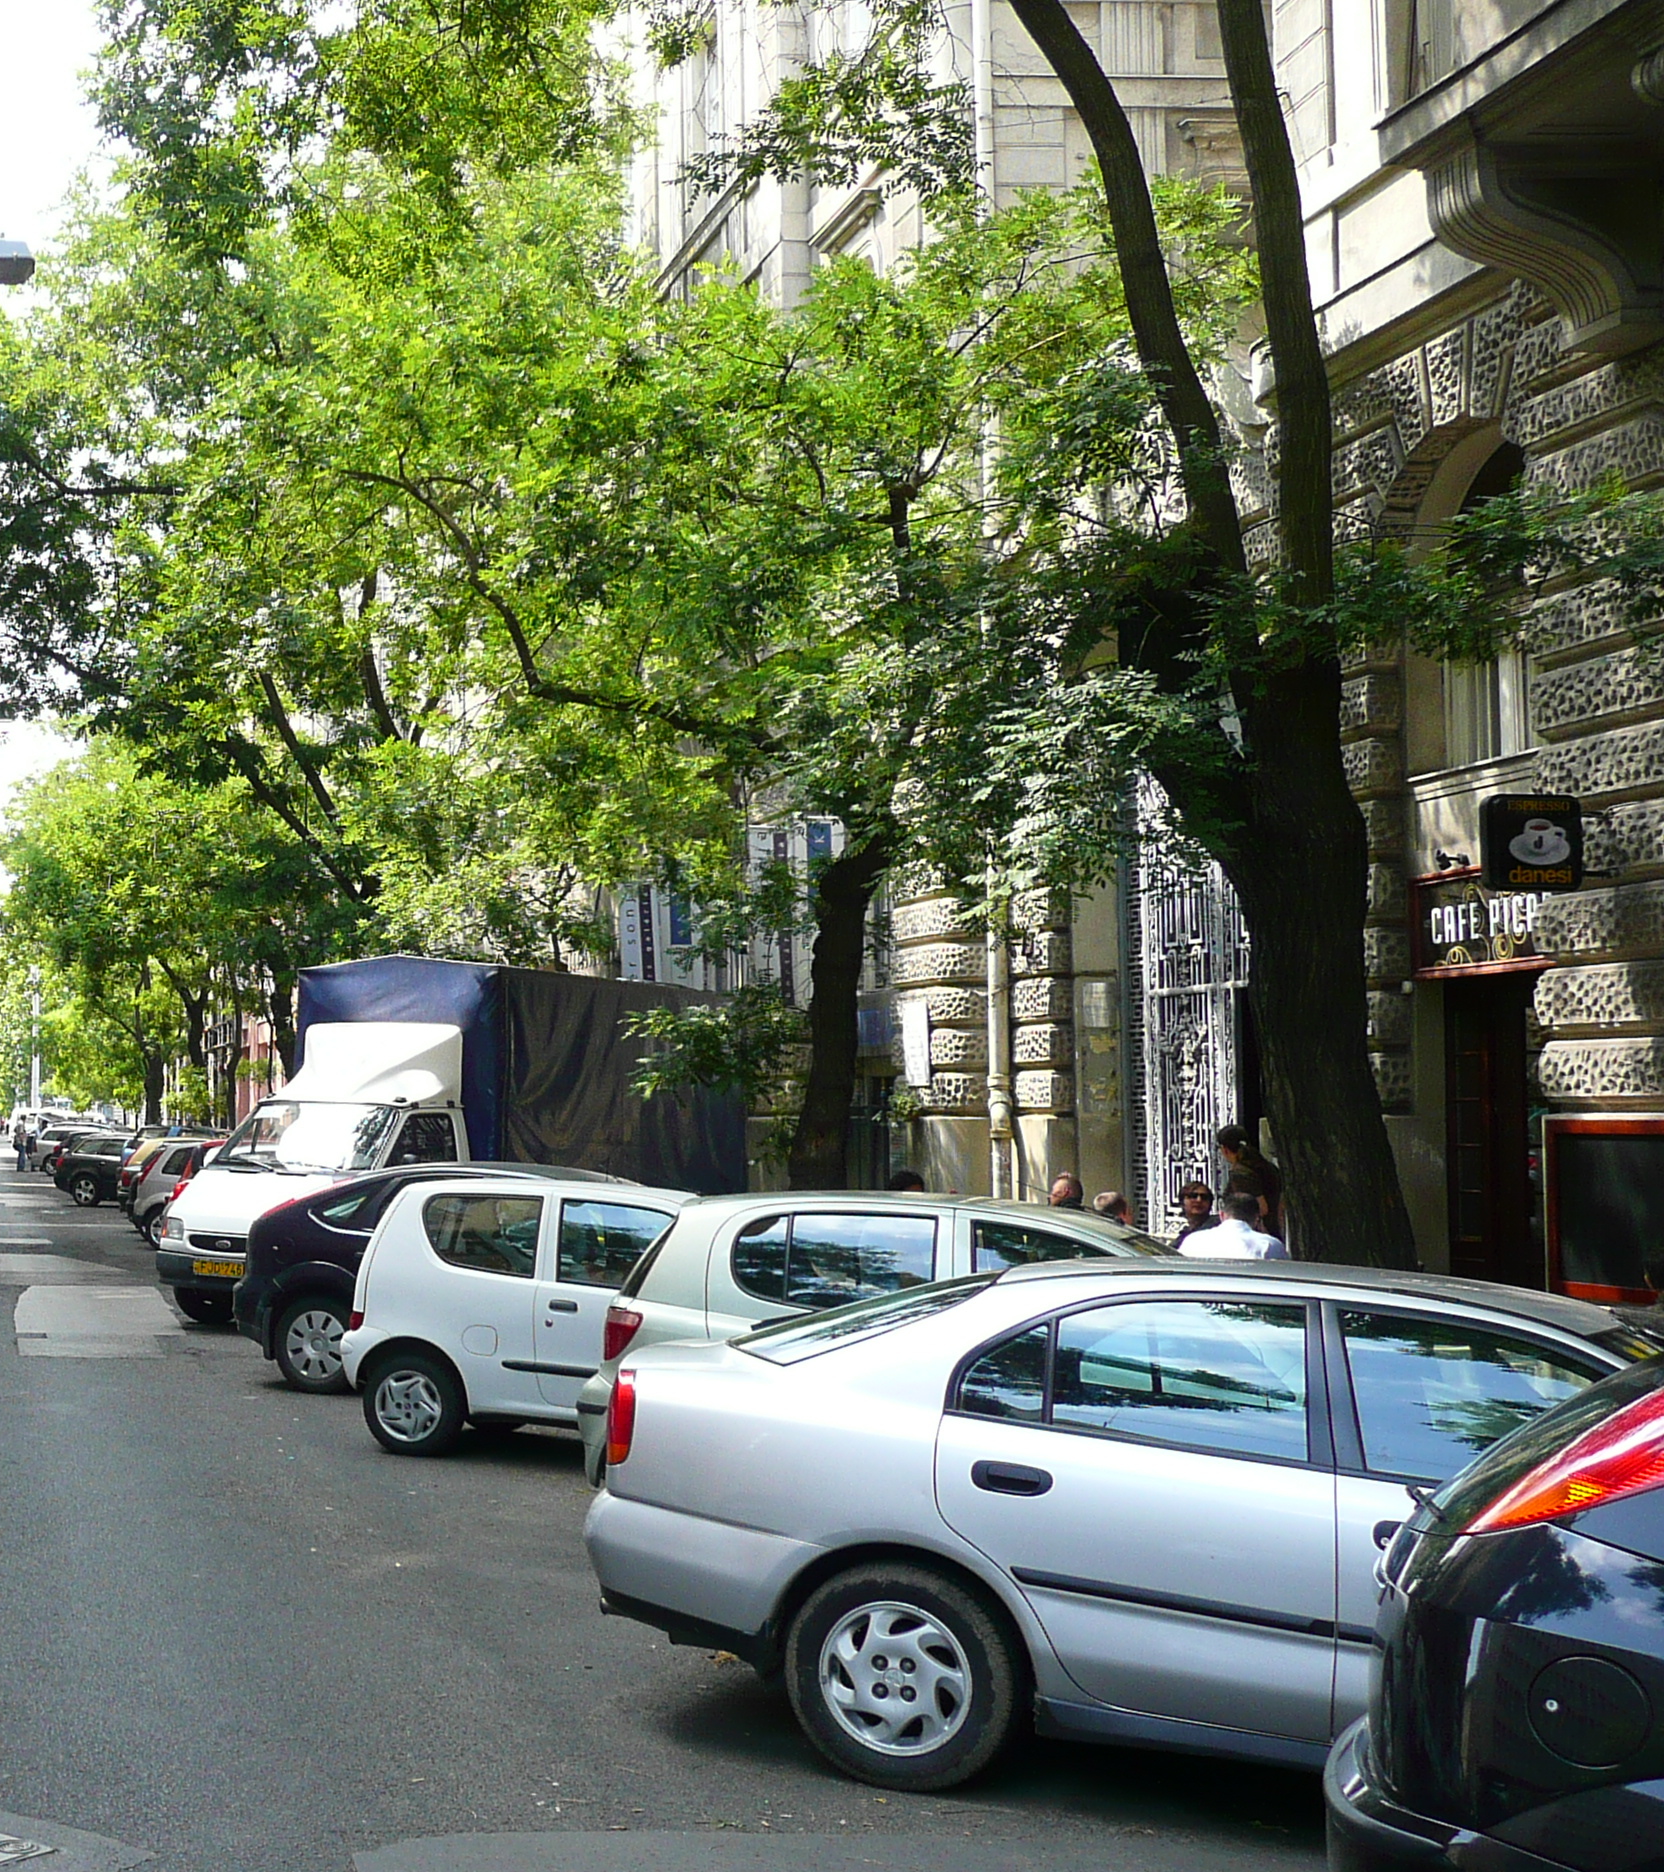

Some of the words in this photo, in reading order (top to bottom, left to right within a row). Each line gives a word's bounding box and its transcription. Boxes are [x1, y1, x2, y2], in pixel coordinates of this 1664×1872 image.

[1507, 800, 1570, 811] ESPRESSO
[1509, 866, 1572, 884] danesi
[1431, 902, 1479, 944] CAFE
